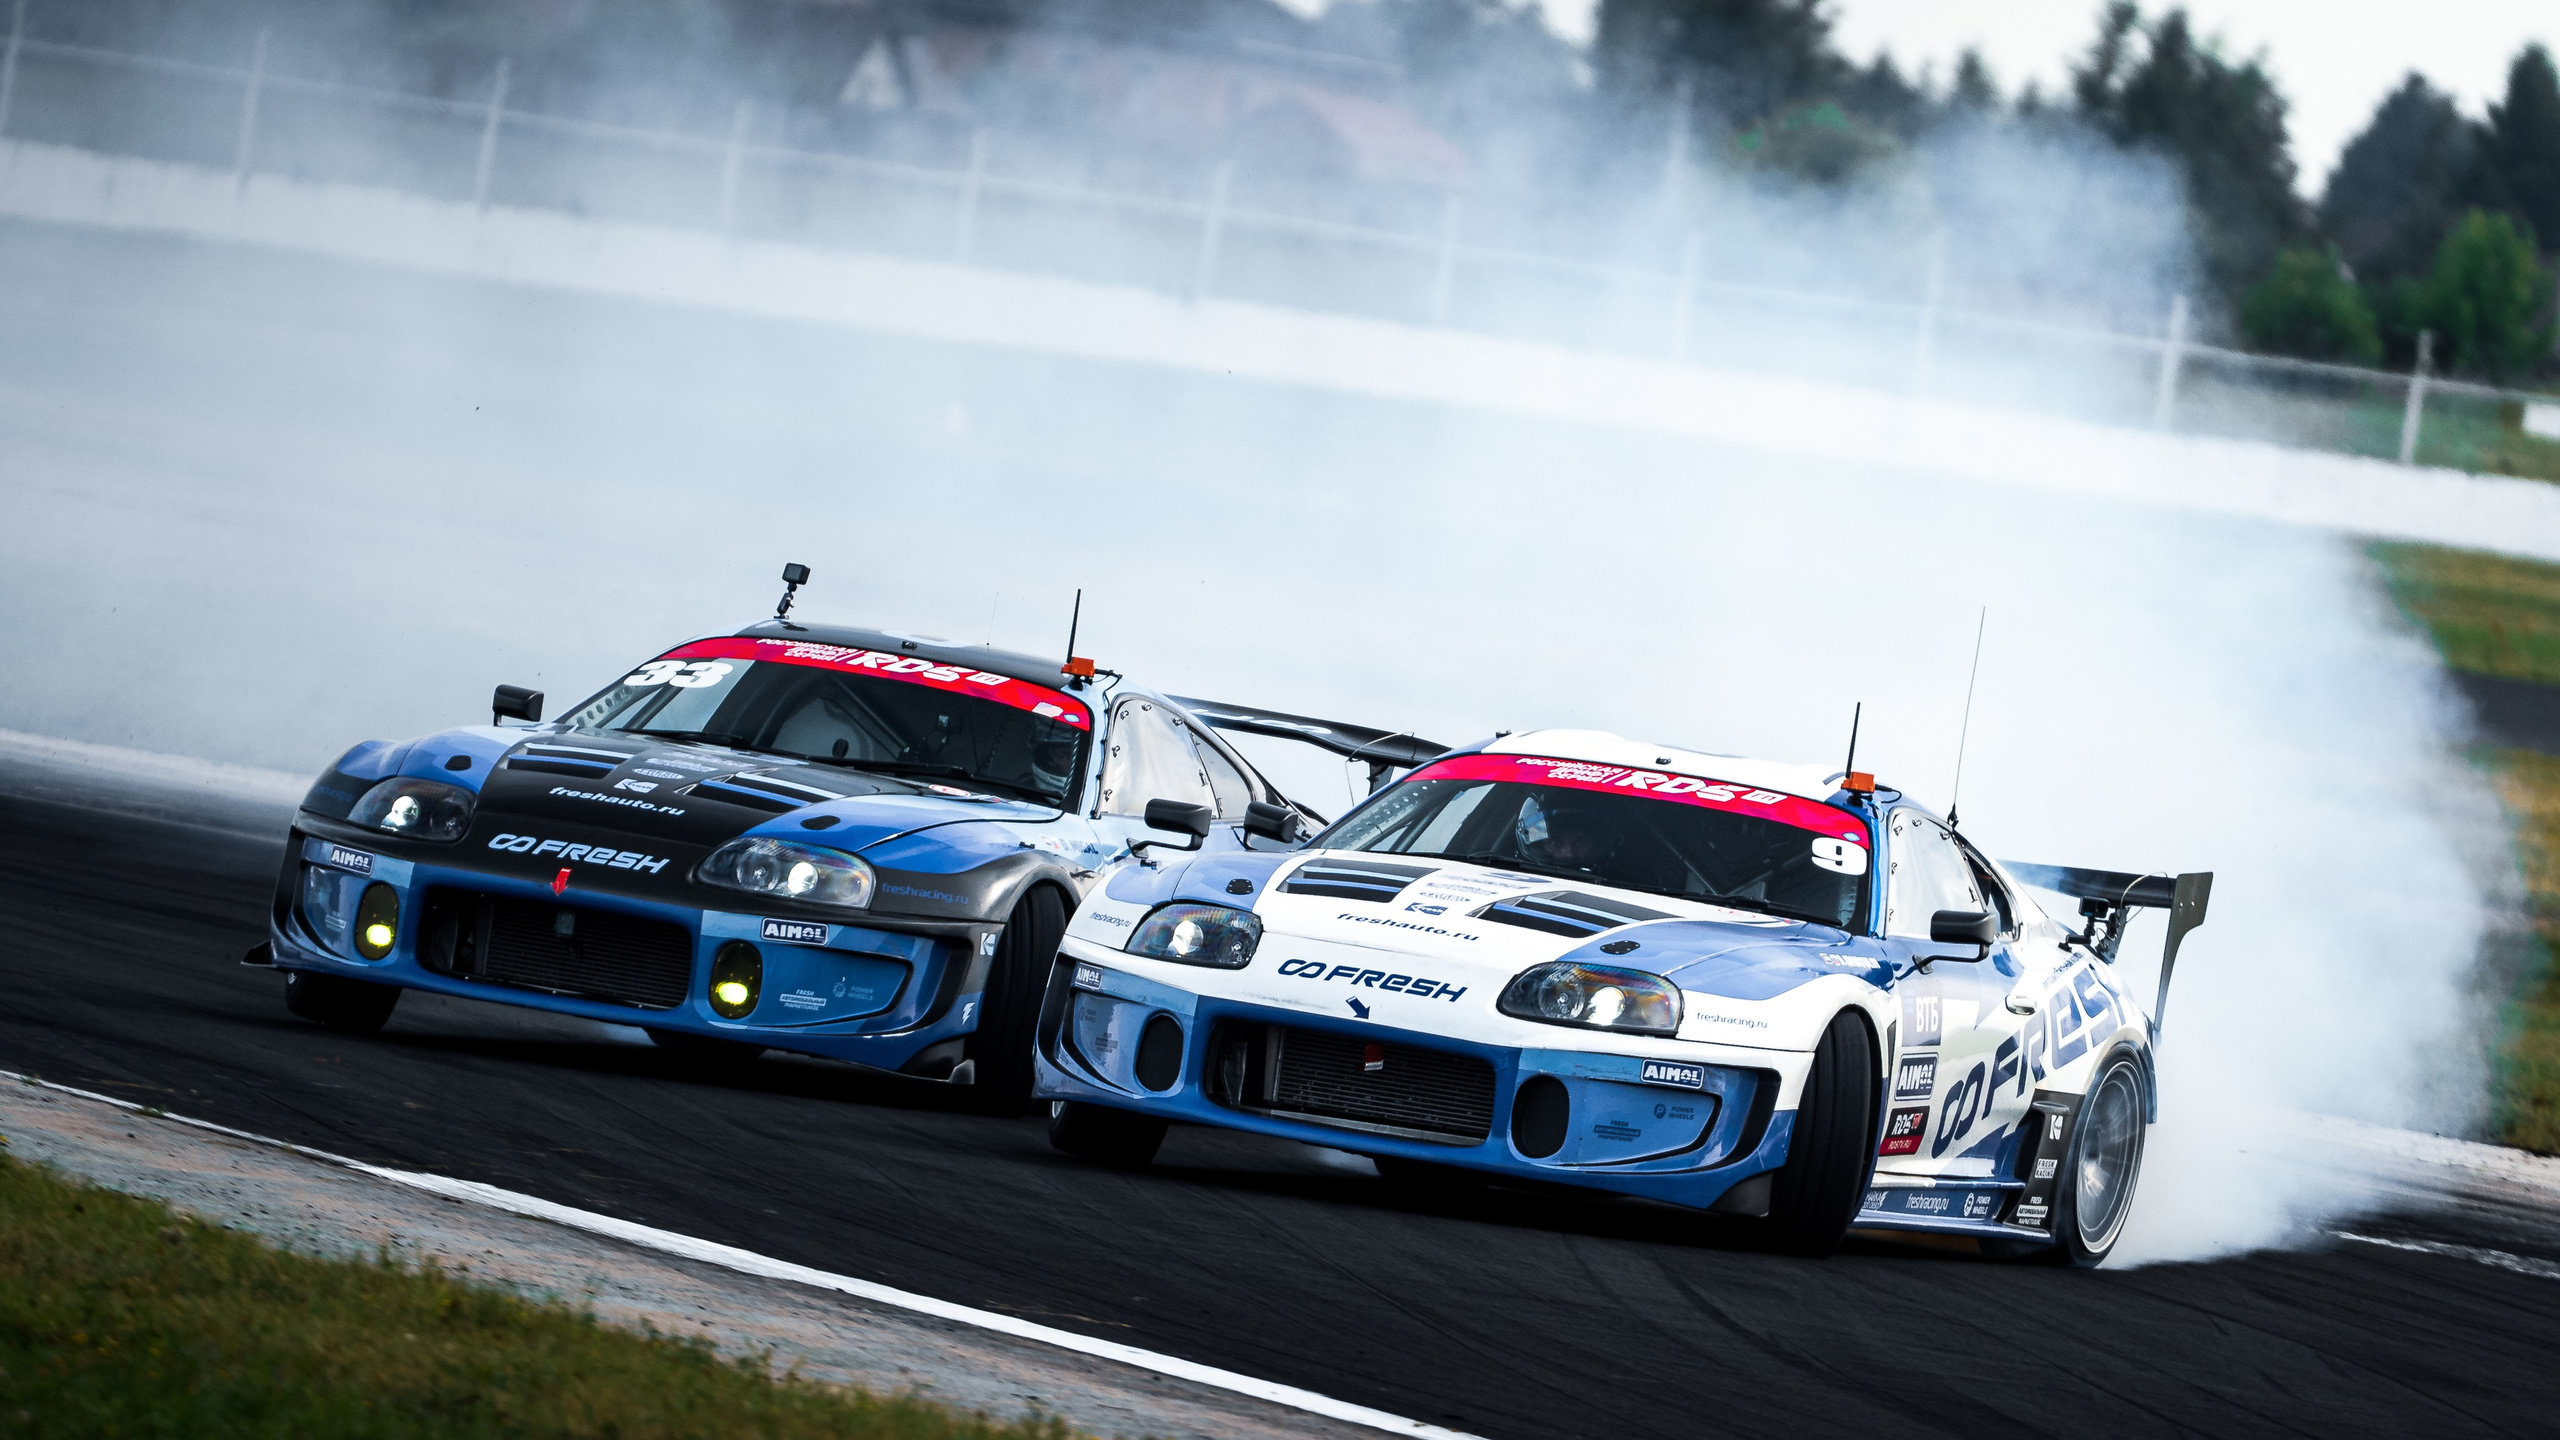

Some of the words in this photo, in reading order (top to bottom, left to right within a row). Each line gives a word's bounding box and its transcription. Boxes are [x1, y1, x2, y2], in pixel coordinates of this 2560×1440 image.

[623, 660, 733, 688] 33
[848, 651, 975, 683] RDS
[1614, 770, 1751, 802] RDS
[549, 786, 686, 816] freshauto.ru
[331, 850, 371, 869] AIMOL
[1811, 836, 1867, 876] 9
[881, 882, 970, 905] freshracing.ru
[764, 923, 826, 941] AIMOL
[1337, 913, 1480, 942] freshauto.ru
[1076, 967, 1100, 983] AIMOL
[1697, 1012, 1768, 1029] freshracing.ru
[1915, 996, 1939, 1033] ВТБ
[1643, 1065, 1701, 1083] AIMOL
[1898, 1062, 1934, 1090] AIMOL
[1668, 1112, 1695, 1121] WHEELS
[1671, 1106, 1695, 1114] POWER
[2035, 1168, 2054, 1178] RACING
[2037, 1160, 2056, 1169] FRESH
[1905, 1193, 1949, 1213] freshracing.ru
